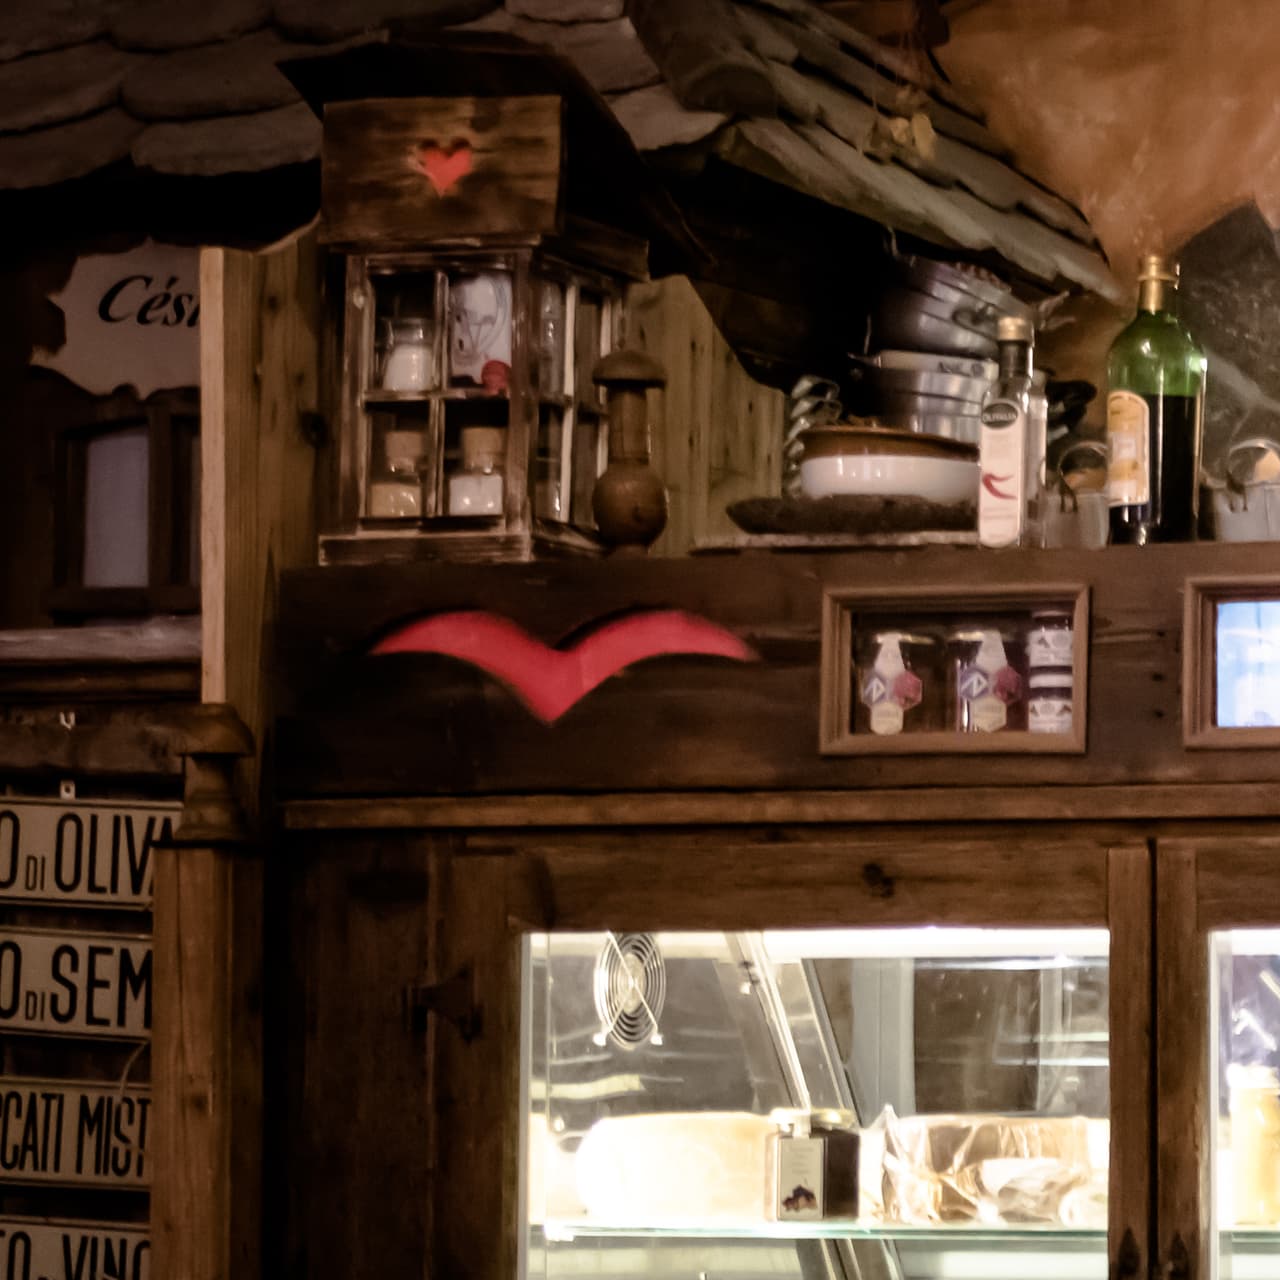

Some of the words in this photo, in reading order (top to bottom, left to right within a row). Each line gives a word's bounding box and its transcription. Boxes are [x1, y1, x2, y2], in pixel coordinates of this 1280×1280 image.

[25, 855, 46, 891] DI
[25, 990, 46, 1021] DI
[50, 944, 152, 1029] SEM
[0, 1091, 64, 1173] CATI
[75, 1094, 152, 1177] MIST
